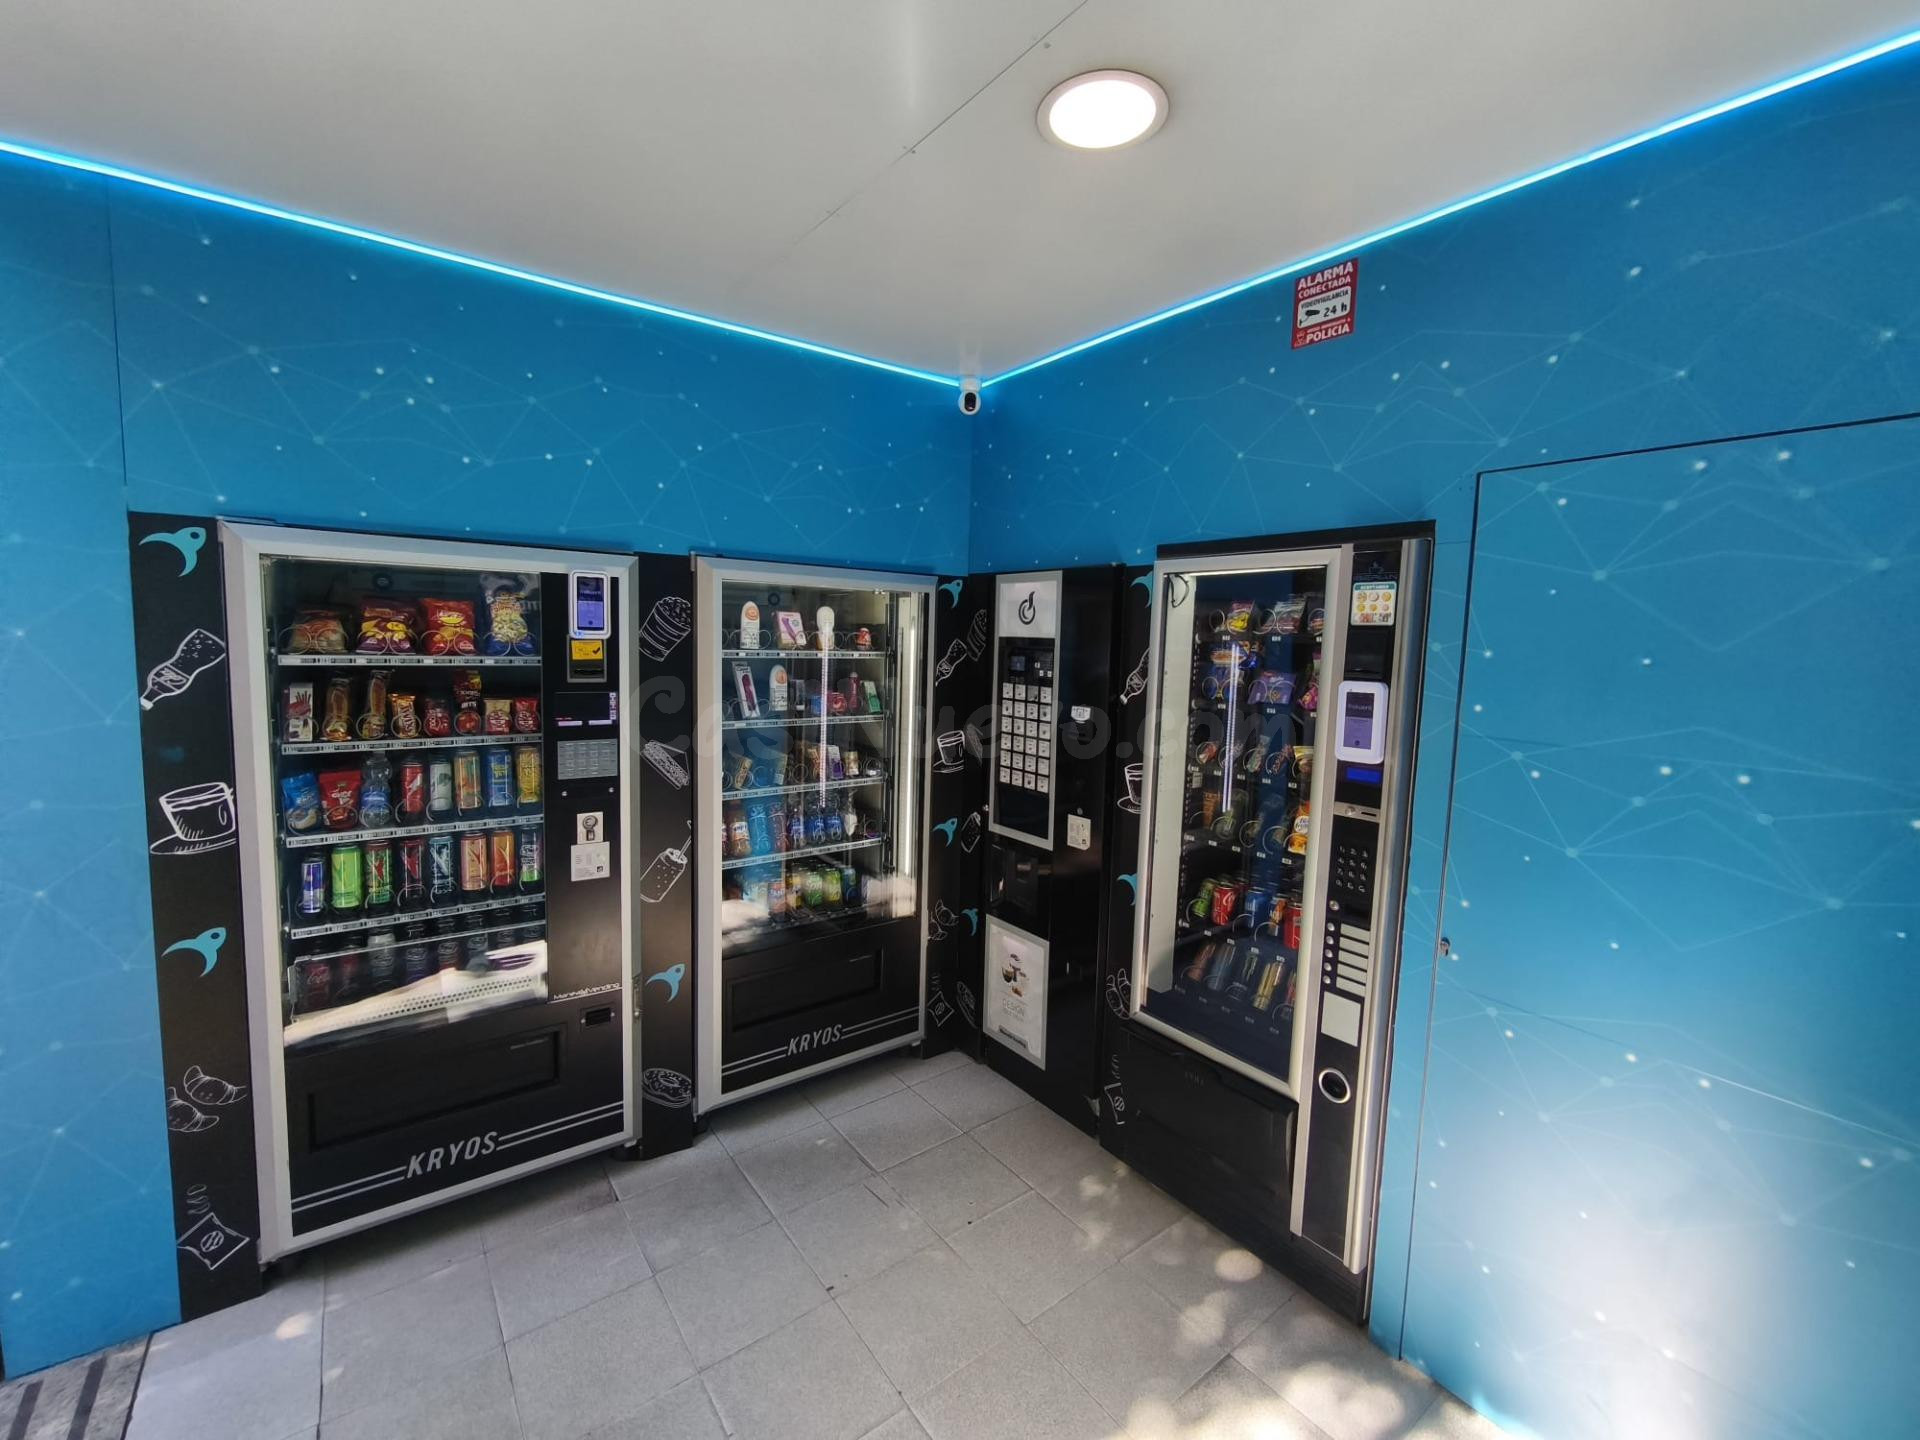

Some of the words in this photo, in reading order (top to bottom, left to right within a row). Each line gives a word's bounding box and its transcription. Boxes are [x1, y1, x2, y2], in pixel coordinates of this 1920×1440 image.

[1298, 262, 1354, 290] ALARMA
[1298, 275, 1351, 299] CONECTADA
[1323, 305, 1337, 318] 24
[1306, 323, 1350, 344] POLICIA
[788, 1024, 842, 1056] KRYOS
[407, 1131, 498, 1179] KRYOS
